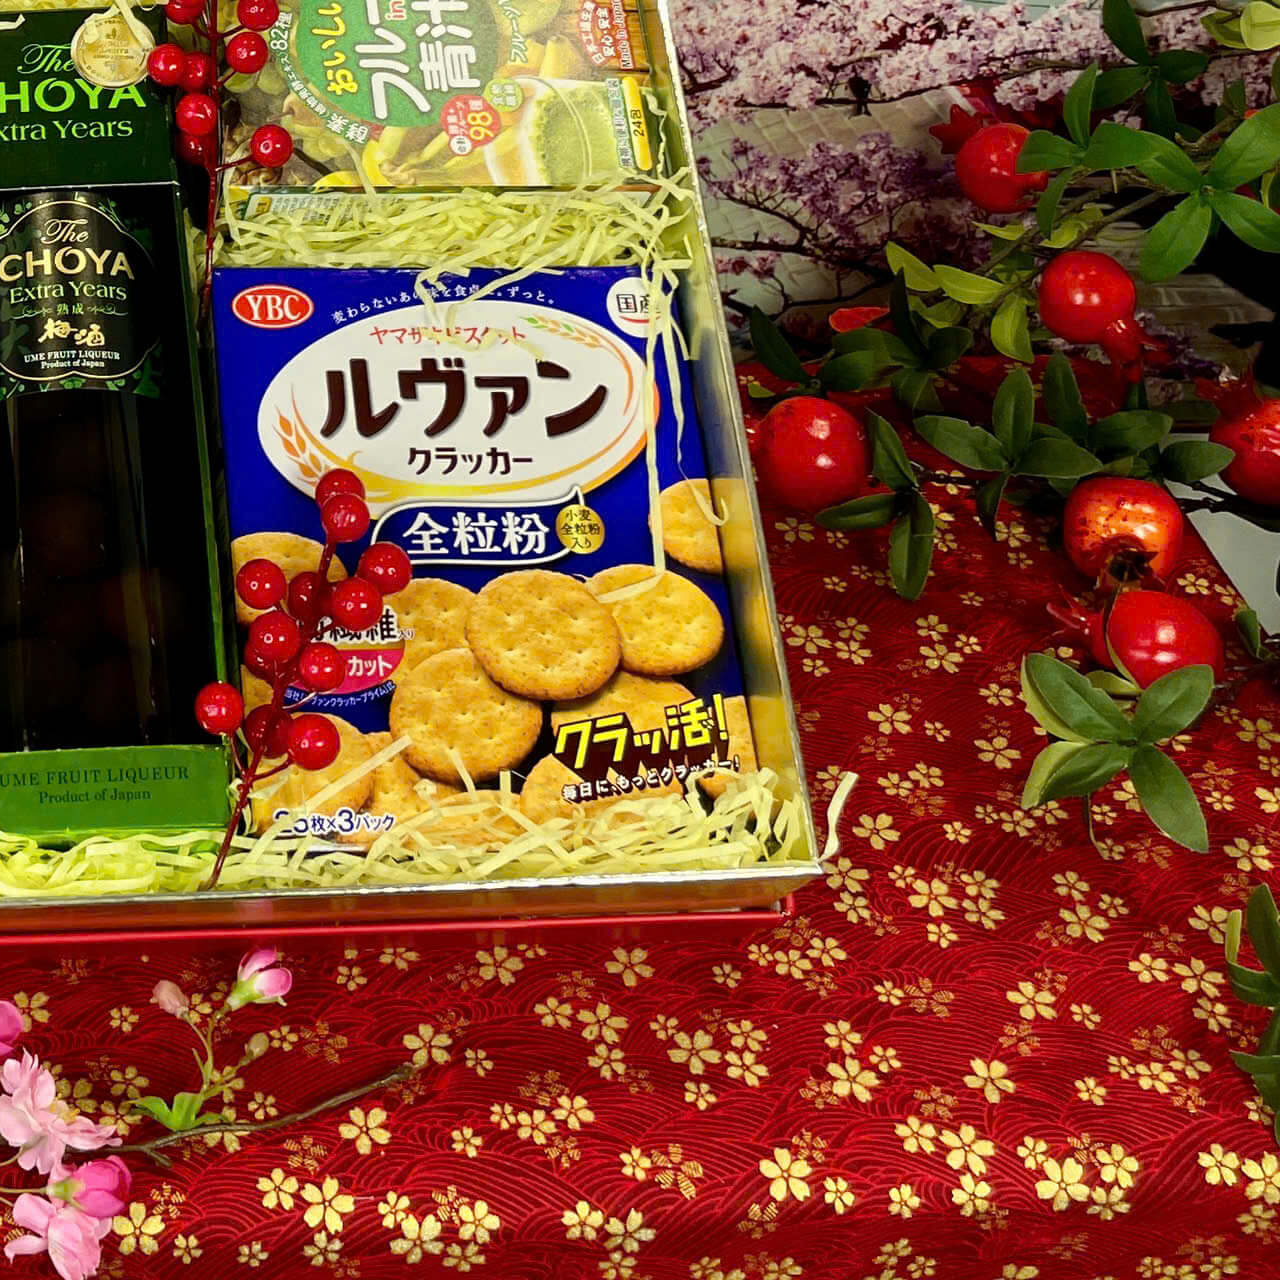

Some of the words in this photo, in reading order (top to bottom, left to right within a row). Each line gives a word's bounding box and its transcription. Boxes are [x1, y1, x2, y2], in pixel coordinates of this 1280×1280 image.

[617, 30, 628, 40] in
[17, 43, 76, 74] The
[620, 40, 632, 69] Made
[53, 120, 133, 139] Years
[631, 110, 644, 137] 24包
[40, 219, 88, 244] The
[9, 283, 65, 305] Extra
[69, 281, 128, 301] Years
[246, 294, 302, 320] YBC
[24, 352, 45, 363] UME
[47, 350, 77, 361] FRUIT
[78, 350, 120, 360] LIQUEUR
[41, 361, 71, 369] Product
[81, 360, 105, 368] Japan
[319, 357, 609, 439] ルヴァン
[407, 446, 533, 476] クラッカー
[565, 509, 592, 521] 小麦
[402, 511, 550, 556] 全粒粉
[560, 523, 600, 535] 全粒粉
[570, 537, 592, 549] 入り
[348, 655, 393, 677] カット
[554, 693, 729, 769] クラッ活!
[0, 772, 40, 788] UME
[46, 768, 101, 786] FRUIT
[107, 766, 190, 783] LIQUEUR
[38, 788, 89, 804] Product
[94, 787, 108, 801] of
[109, 787, 152, 801] Japan
